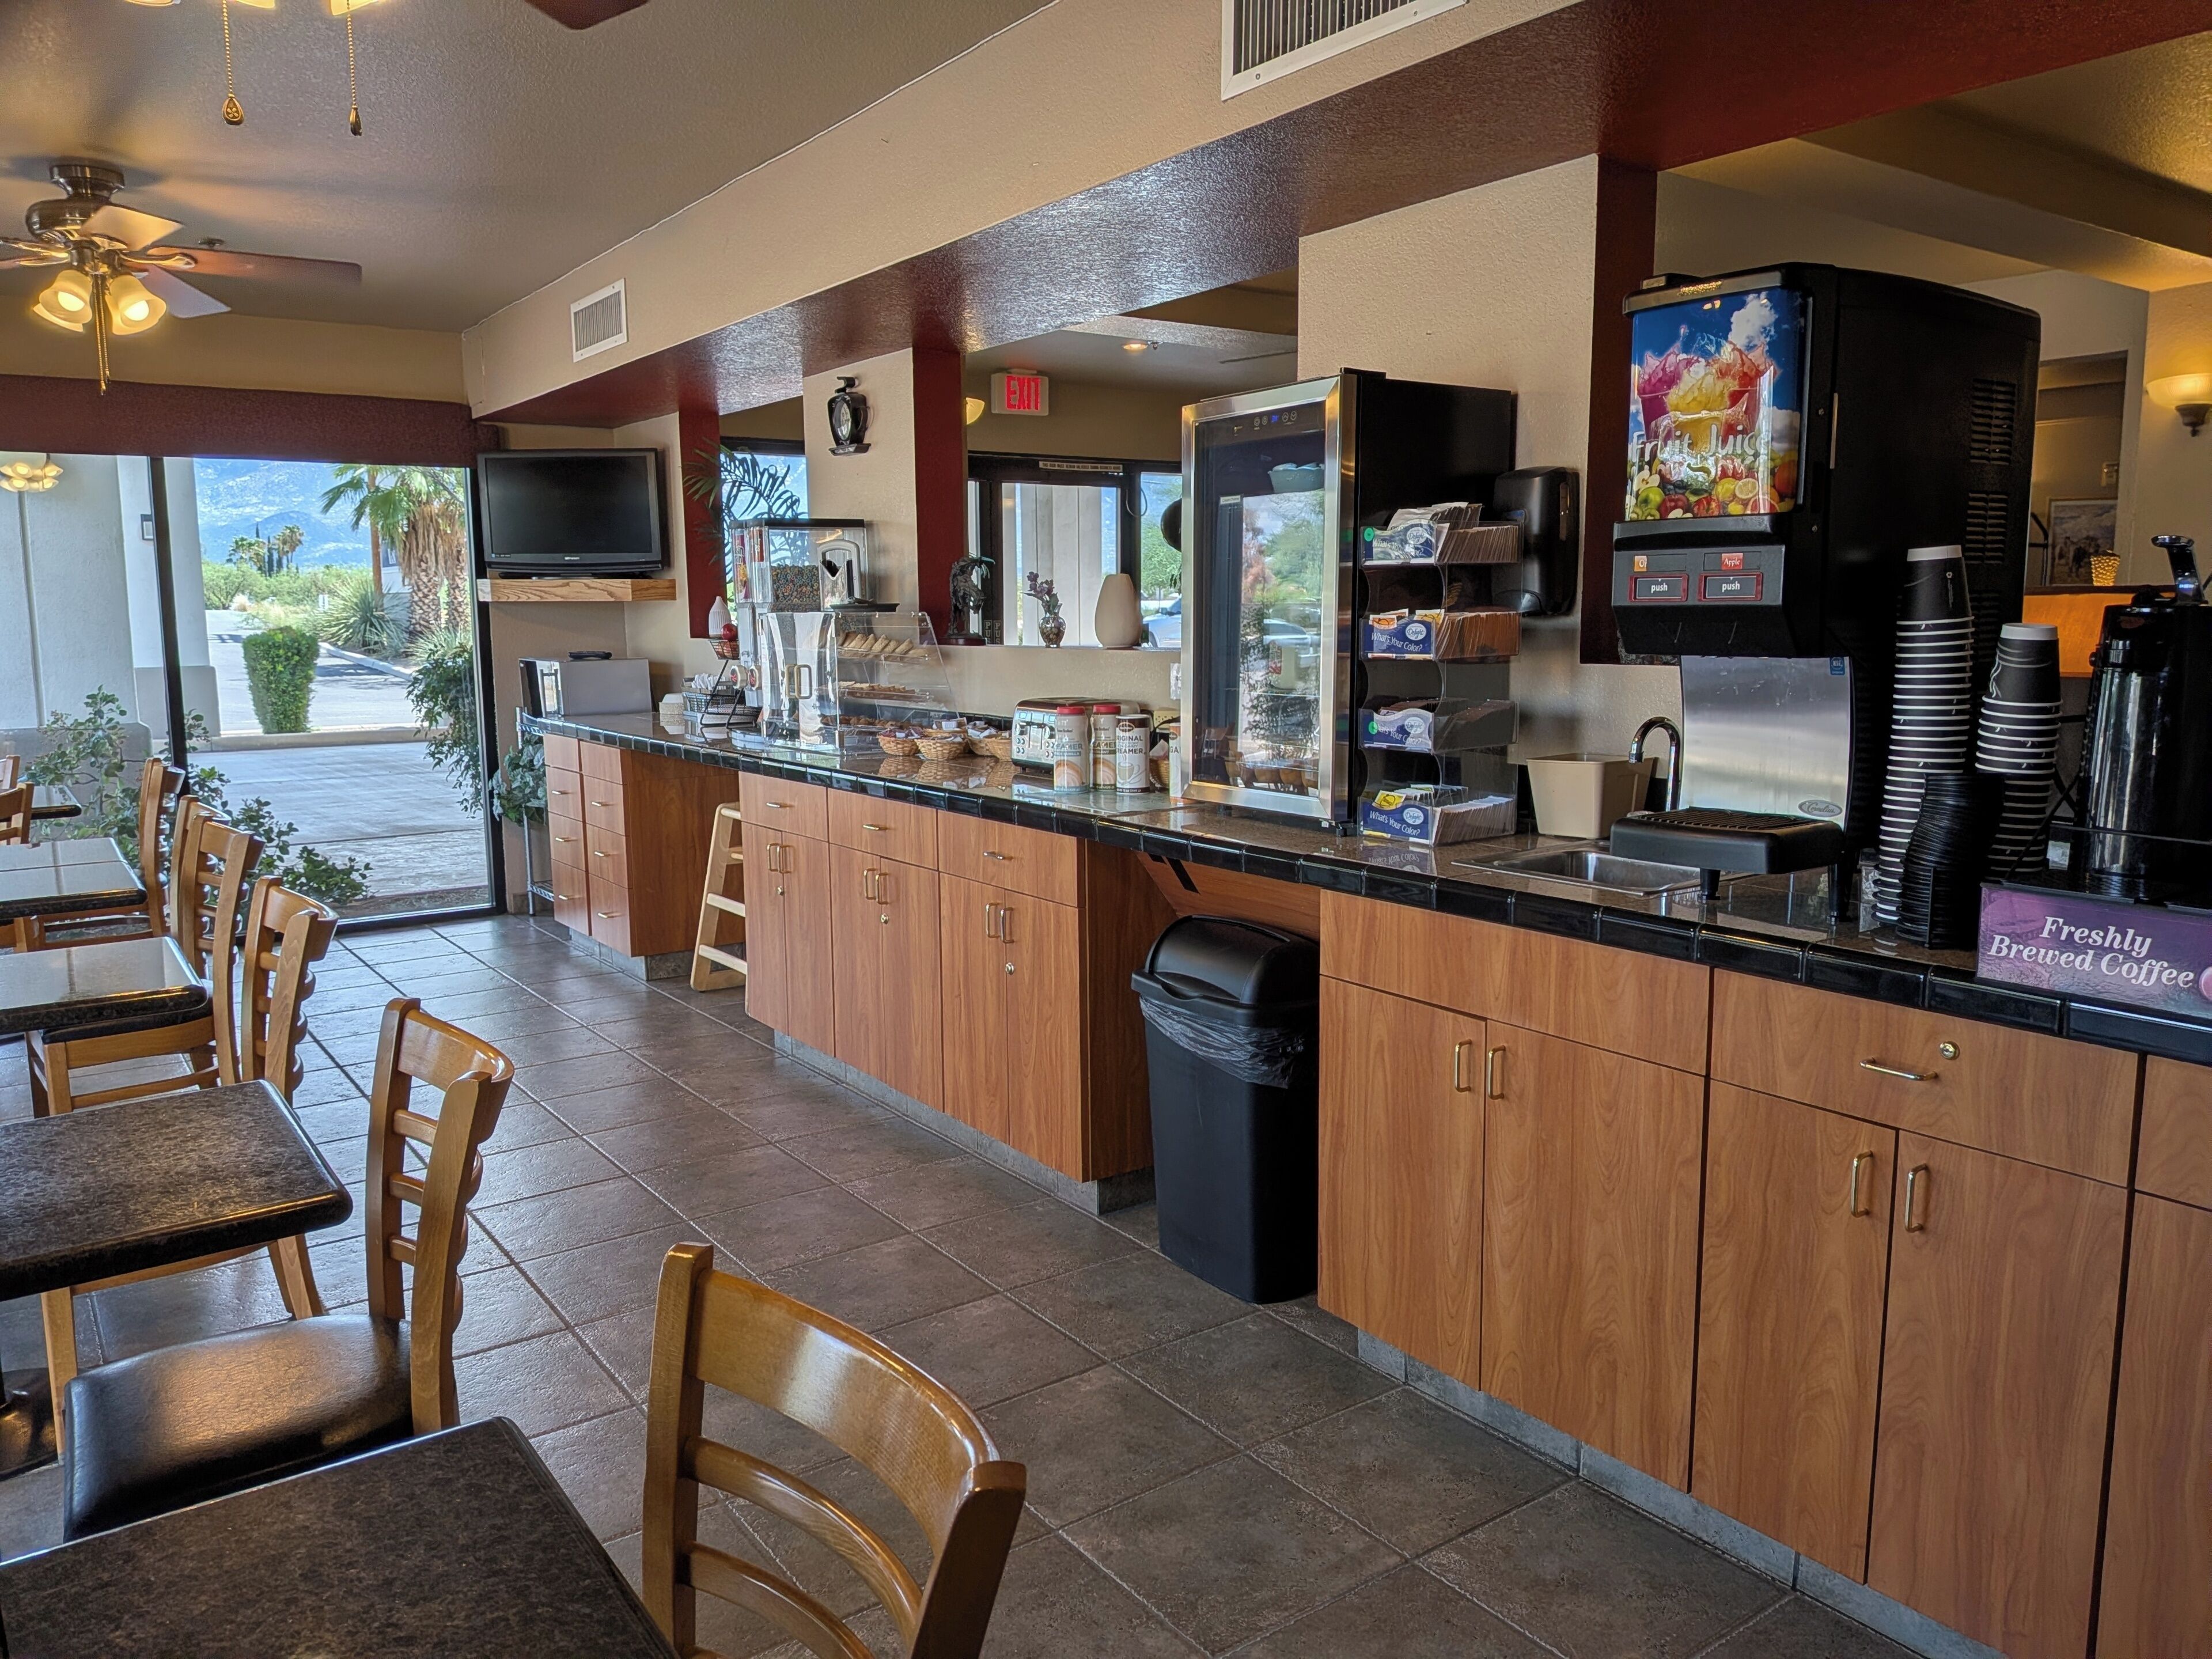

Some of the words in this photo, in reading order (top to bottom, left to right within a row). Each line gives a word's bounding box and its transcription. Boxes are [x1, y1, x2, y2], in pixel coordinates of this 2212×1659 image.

[1005, 375, 1041, 411] EXIT
[1632, 430, 1692, 463] Fruit
[1724, 558, 1740, 567] Apple
[1651, 583, 1668, 593] push
[1722, 581, 1740, 593] push
[1372, 632, 1391, 643] What's
[1391, 637, 1403, 647] Your
[1403, 641, 1423, 652] Color?
[1390, 728, 1403, 740] Your
[1403, 734, 1422, 745] Color?
[1370, 810, 1389, 823] What's
[1389, 817, 1402, 830] Your
[1402, 824, 1421, 836] Color?
[2039, 915, 2152, 959] Freshly
[1987, 934, 2093, 972] Brewed
[2101, 952, 2195, 988] Coffee
